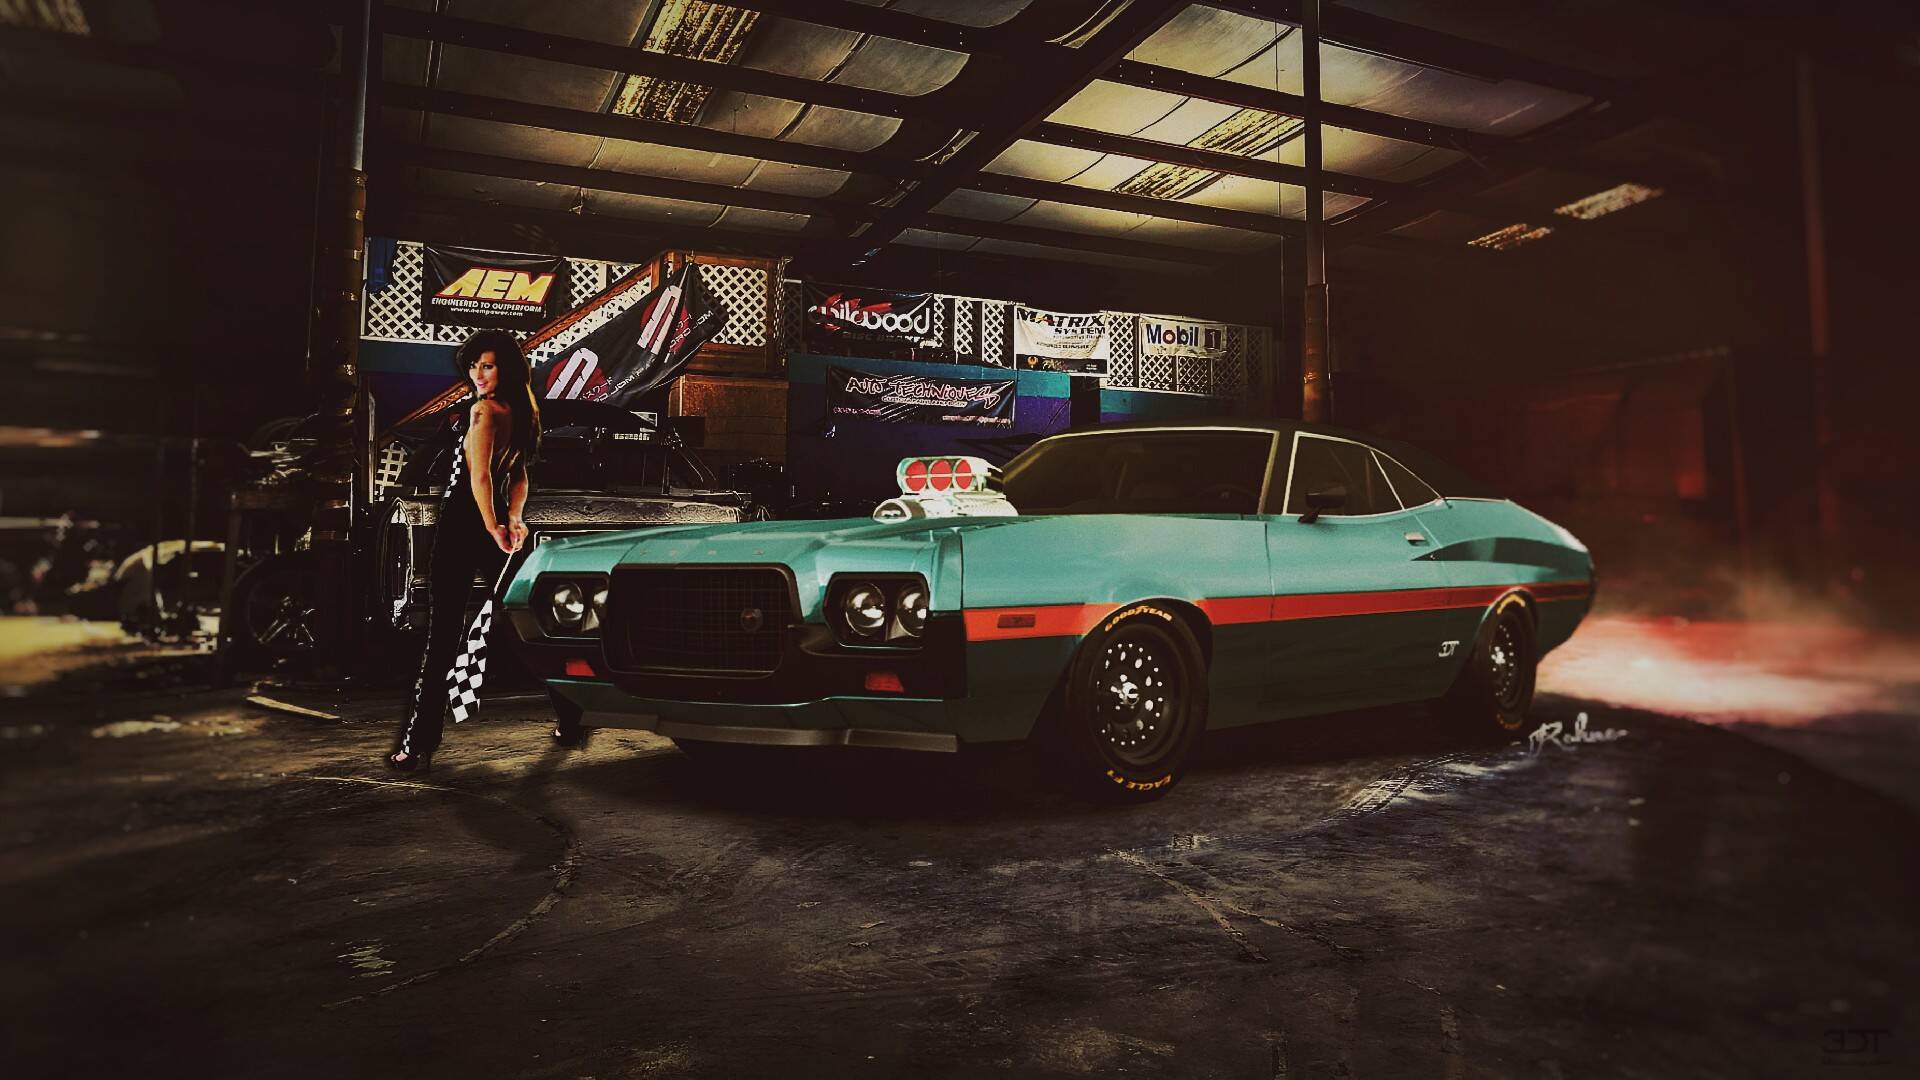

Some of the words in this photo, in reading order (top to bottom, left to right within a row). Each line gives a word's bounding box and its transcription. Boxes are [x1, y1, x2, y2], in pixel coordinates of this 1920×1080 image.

[438, 267, 554, 304] AEM
[431, 297, 479, 308] ENGINEERED
[491, 303, 542, 313] OUTPERFORM
[450, 307, 523, 317] www.aempower.com
[1017, 307, 1107, 327] MATRIX
[1054, 326, 1106, 335] SYSTEM
[1146, 323, 1199, 347] Mobil
[1105, 605, 1172, 632] GOODYEAR
[1126, 773, 1171, 791] EAGLE
